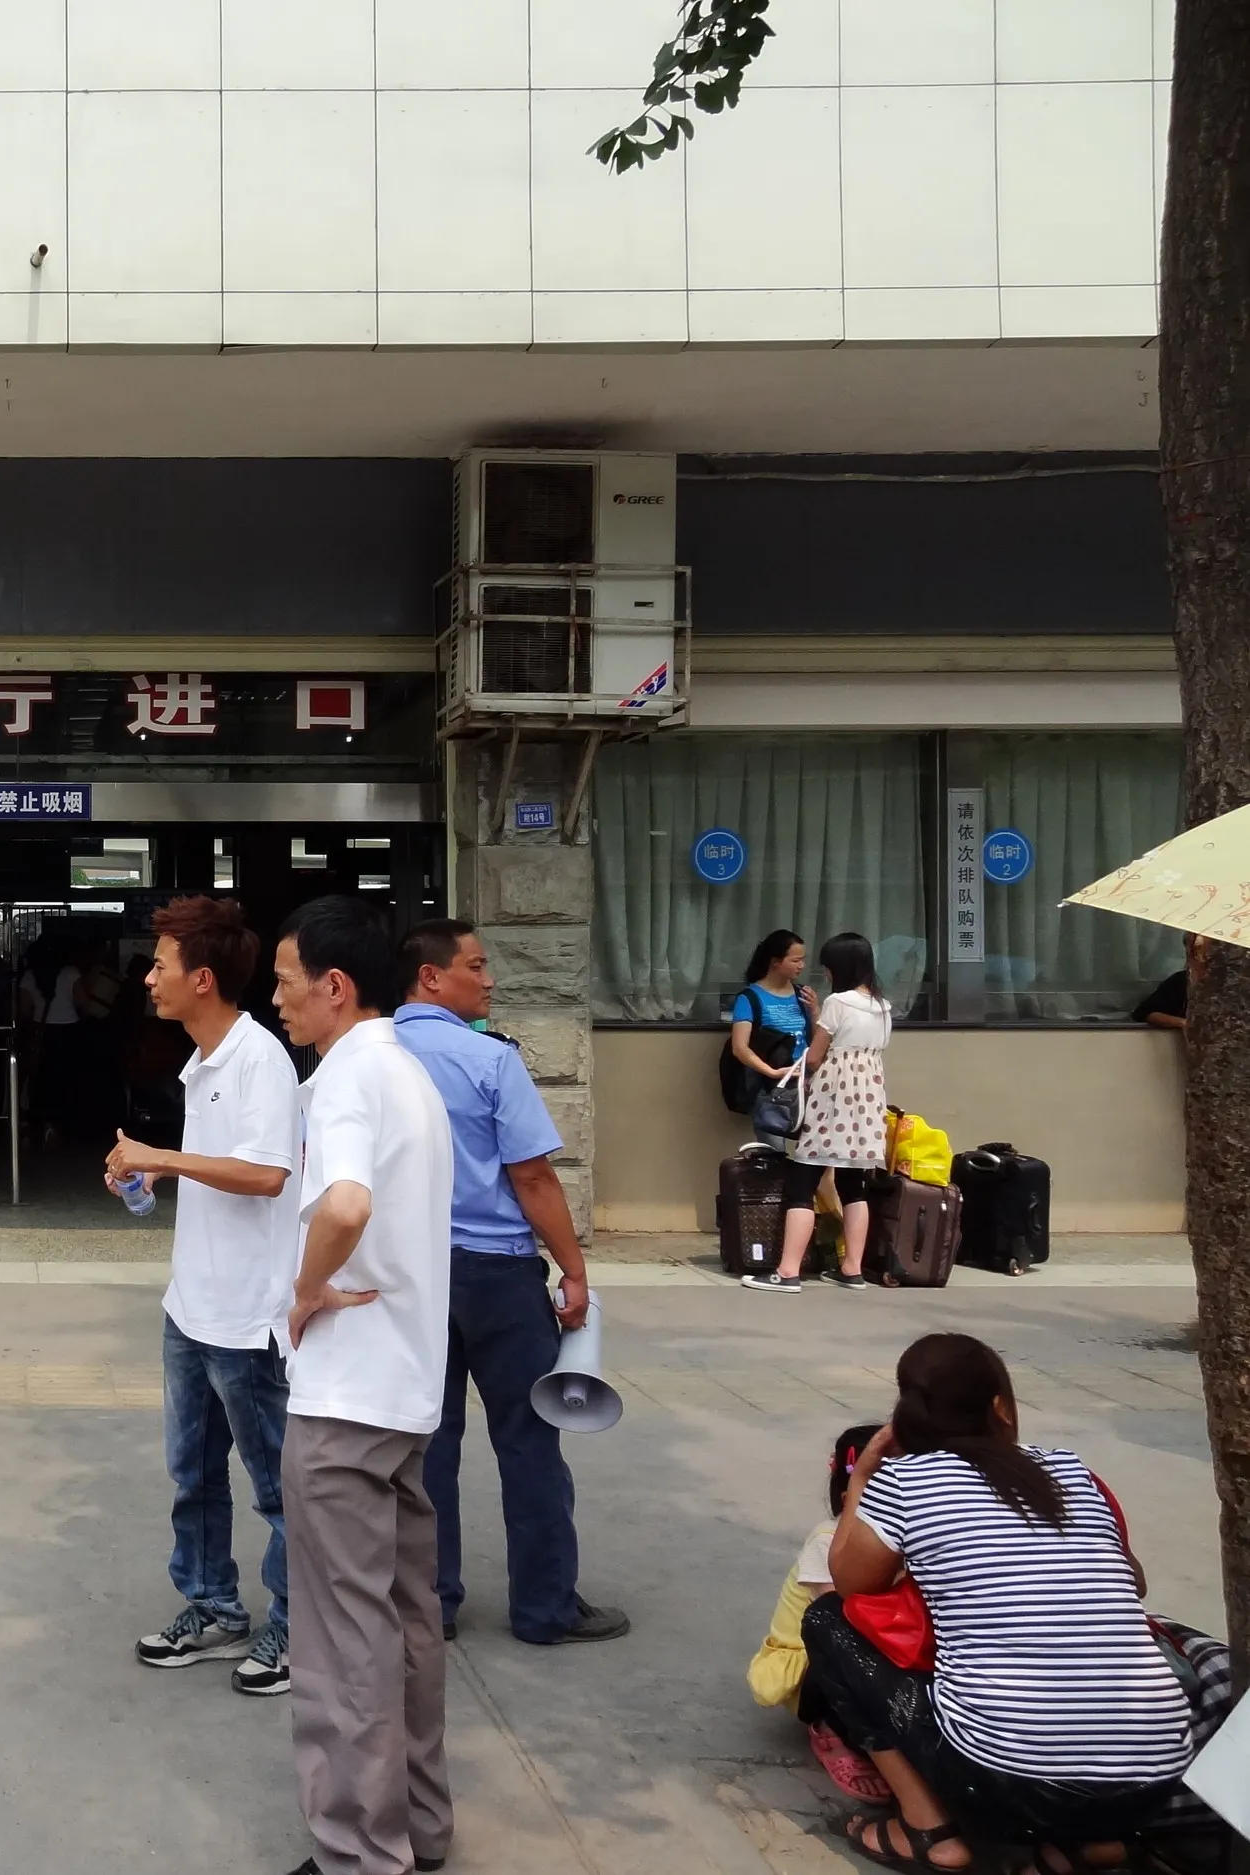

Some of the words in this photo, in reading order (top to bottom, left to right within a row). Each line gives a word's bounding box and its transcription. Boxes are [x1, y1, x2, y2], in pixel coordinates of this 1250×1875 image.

[627, 495, 665, 504] GREE
[704, 844, 735, 860] 临时
[989, 843, 1022, 860] 临时
[717, 863, 726, 876] 3
[957, 801, 976, 949] 请依次排队购票
[1002, 863, 1011, 876] 2
